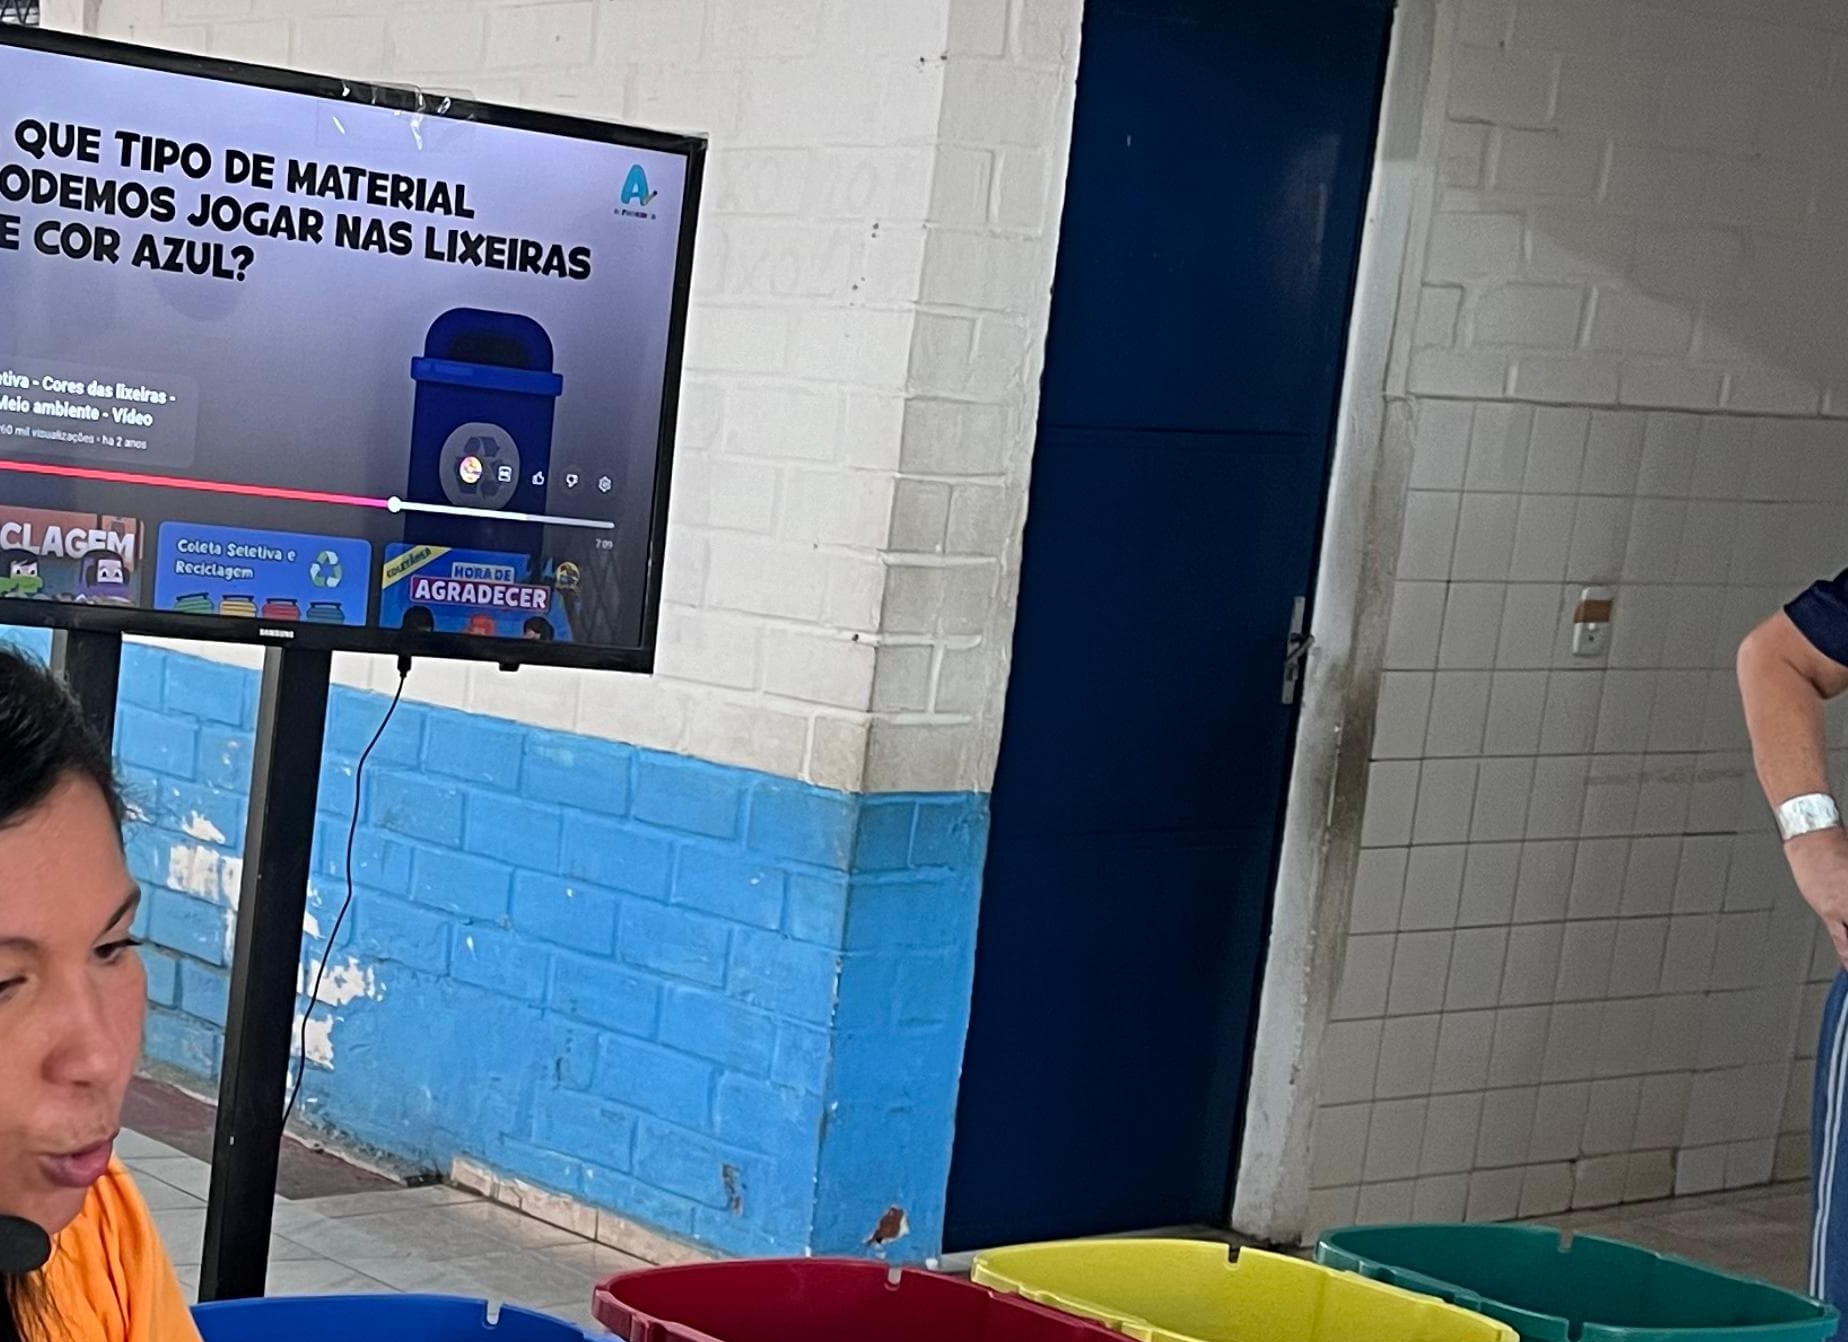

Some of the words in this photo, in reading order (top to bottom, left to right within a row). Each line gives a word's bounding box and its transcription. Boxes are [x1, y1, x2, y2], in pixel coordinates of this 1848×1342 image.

[14, 118, 101, 165] QUE
[115, 129, 212, 179] TIPO
[225, 148, 275, 190] DE
[287, 159, 475, 220] MATERIAL
[32, 221, 121, 264] COR
[131, 236, 255, 283] AZUL?
[187, 194, 323, 247] JOGAR
[334, 214, 414, 258] NAS
[424, 226, 592, 282] LIXEIRAS
[42, 375, 84, 395] Cores
[87, 380, 113, 398] das
[116, 383, 167, 404] lixeiras
[32, 400, 100, 420] ambiente
[112, 407, 154, 427] Vídeo
[178, 538, 222, 557] Coleta
[227, 543, 283, 563] Seletiva
[286, 550, 296, 562] e
[175, 560, 254, 581] Reciclagem
[454, 565, 491, 580] HORA
[495, 568, 512, 582] DE
[414, 579, 547, 609] AGRADECER
